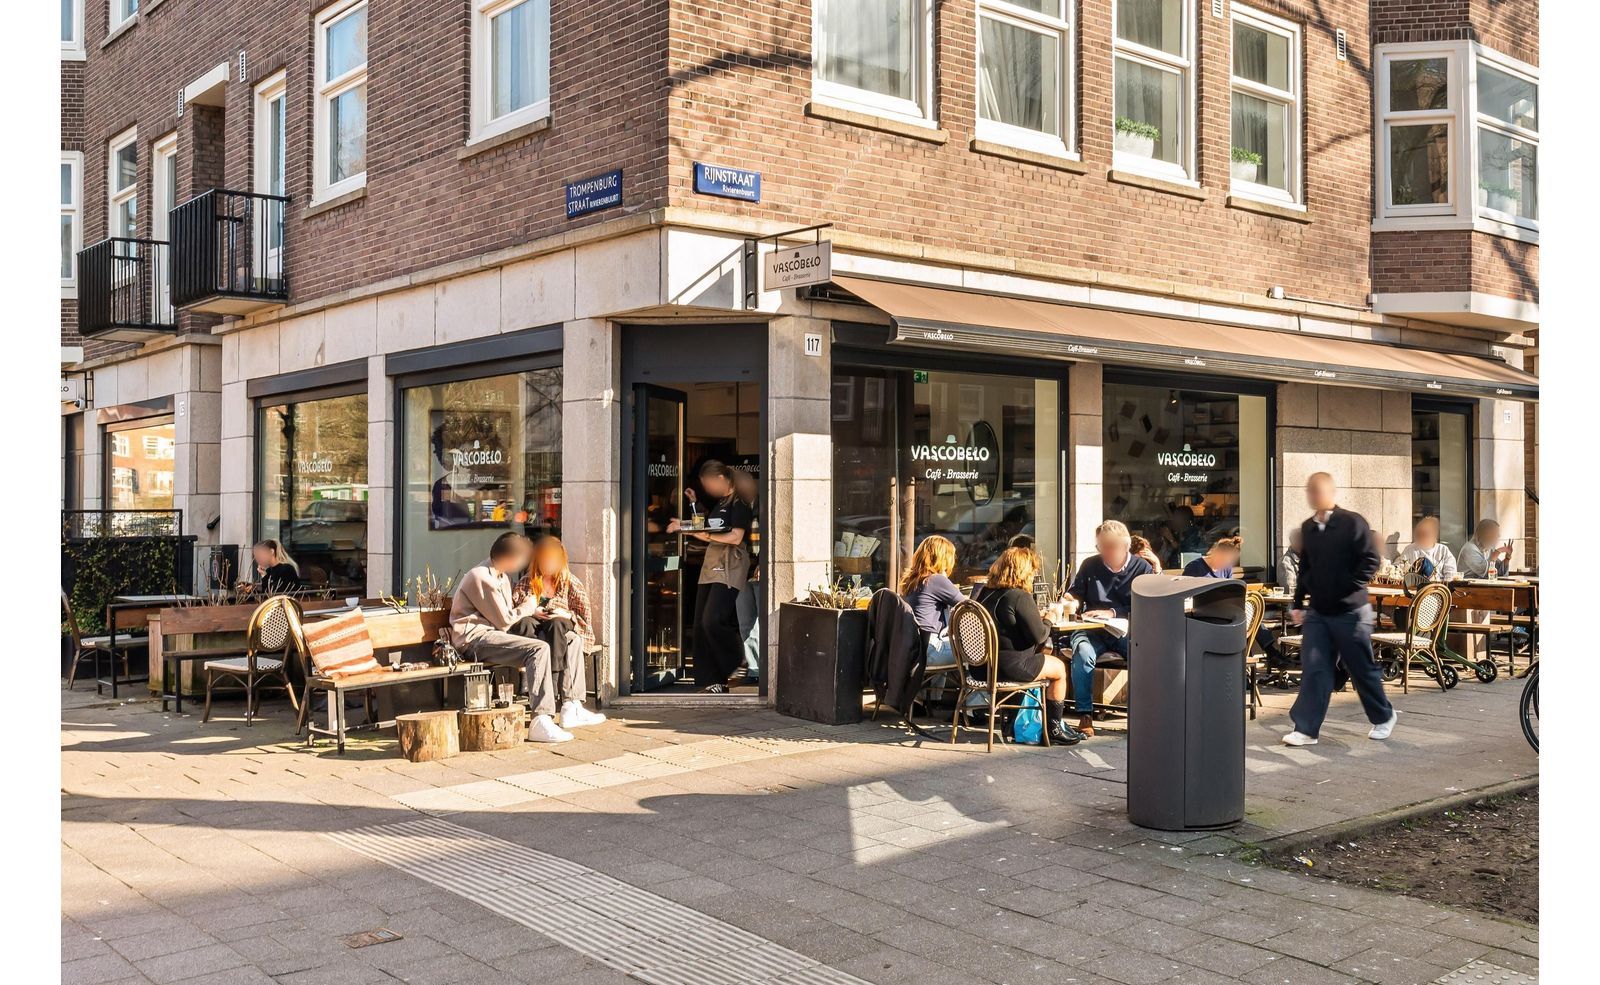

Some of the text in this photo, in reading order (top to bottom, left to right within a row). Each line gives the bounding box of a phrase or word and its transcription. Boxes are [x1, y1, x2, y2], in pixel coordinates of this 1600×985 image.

[704, 166, 755, 187] RIJNSTRAAT
[570, 174, 617, 199] TROMPENBURG
[722, 184, 755, 198] Rivierenbuurt
[568, 193, 619, 214] STRAAT RIVIERENBUURT
[806, 337, 820, 352] 117
[925, 468, 942, 481] Café
[946, 468, 979, 479] Brasserie
[1167, 472, 1181, 483] Café
[1183, 472, 1208, 482] Brasserie
